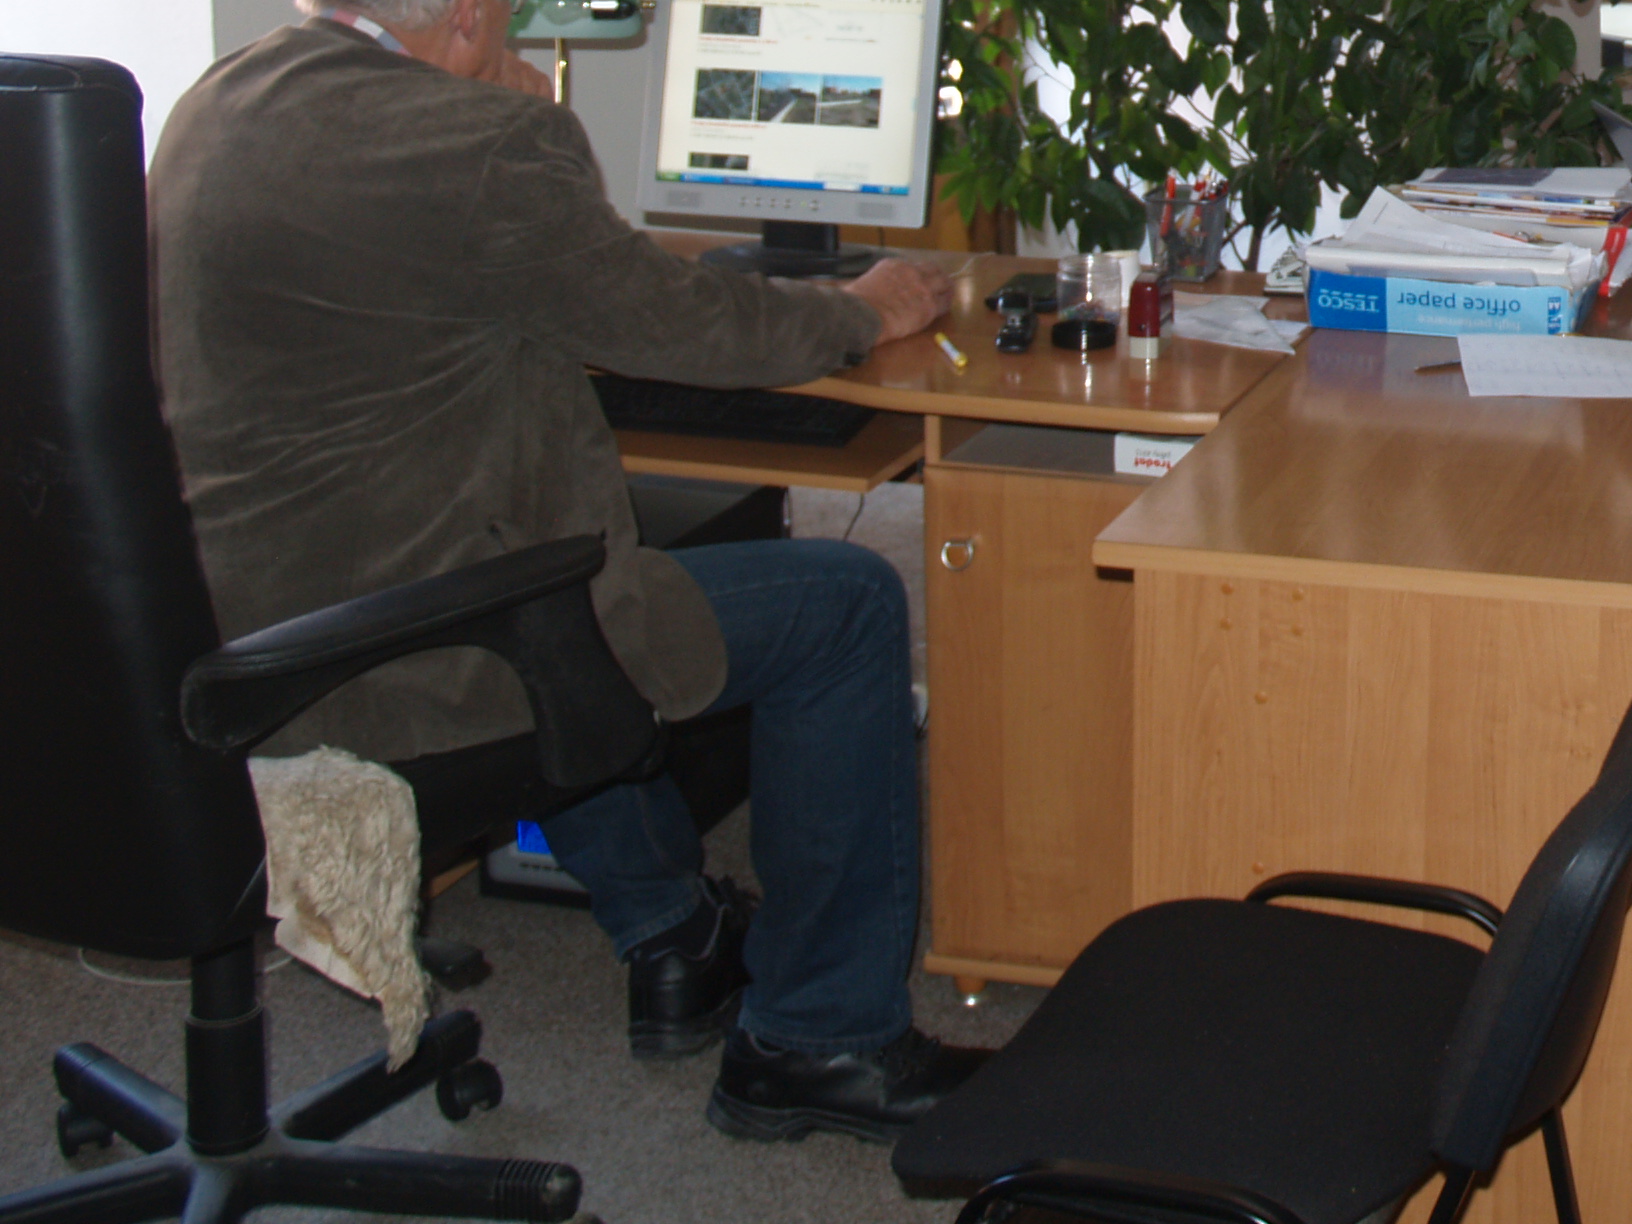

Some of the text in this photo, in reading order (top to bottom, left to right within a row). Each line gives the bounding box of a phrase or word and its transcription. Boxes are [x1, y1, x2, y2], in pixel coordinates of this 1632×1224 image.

[1318, 293, 1380, 313] TESCO
[1396, 289, 1522, 317] office paper
